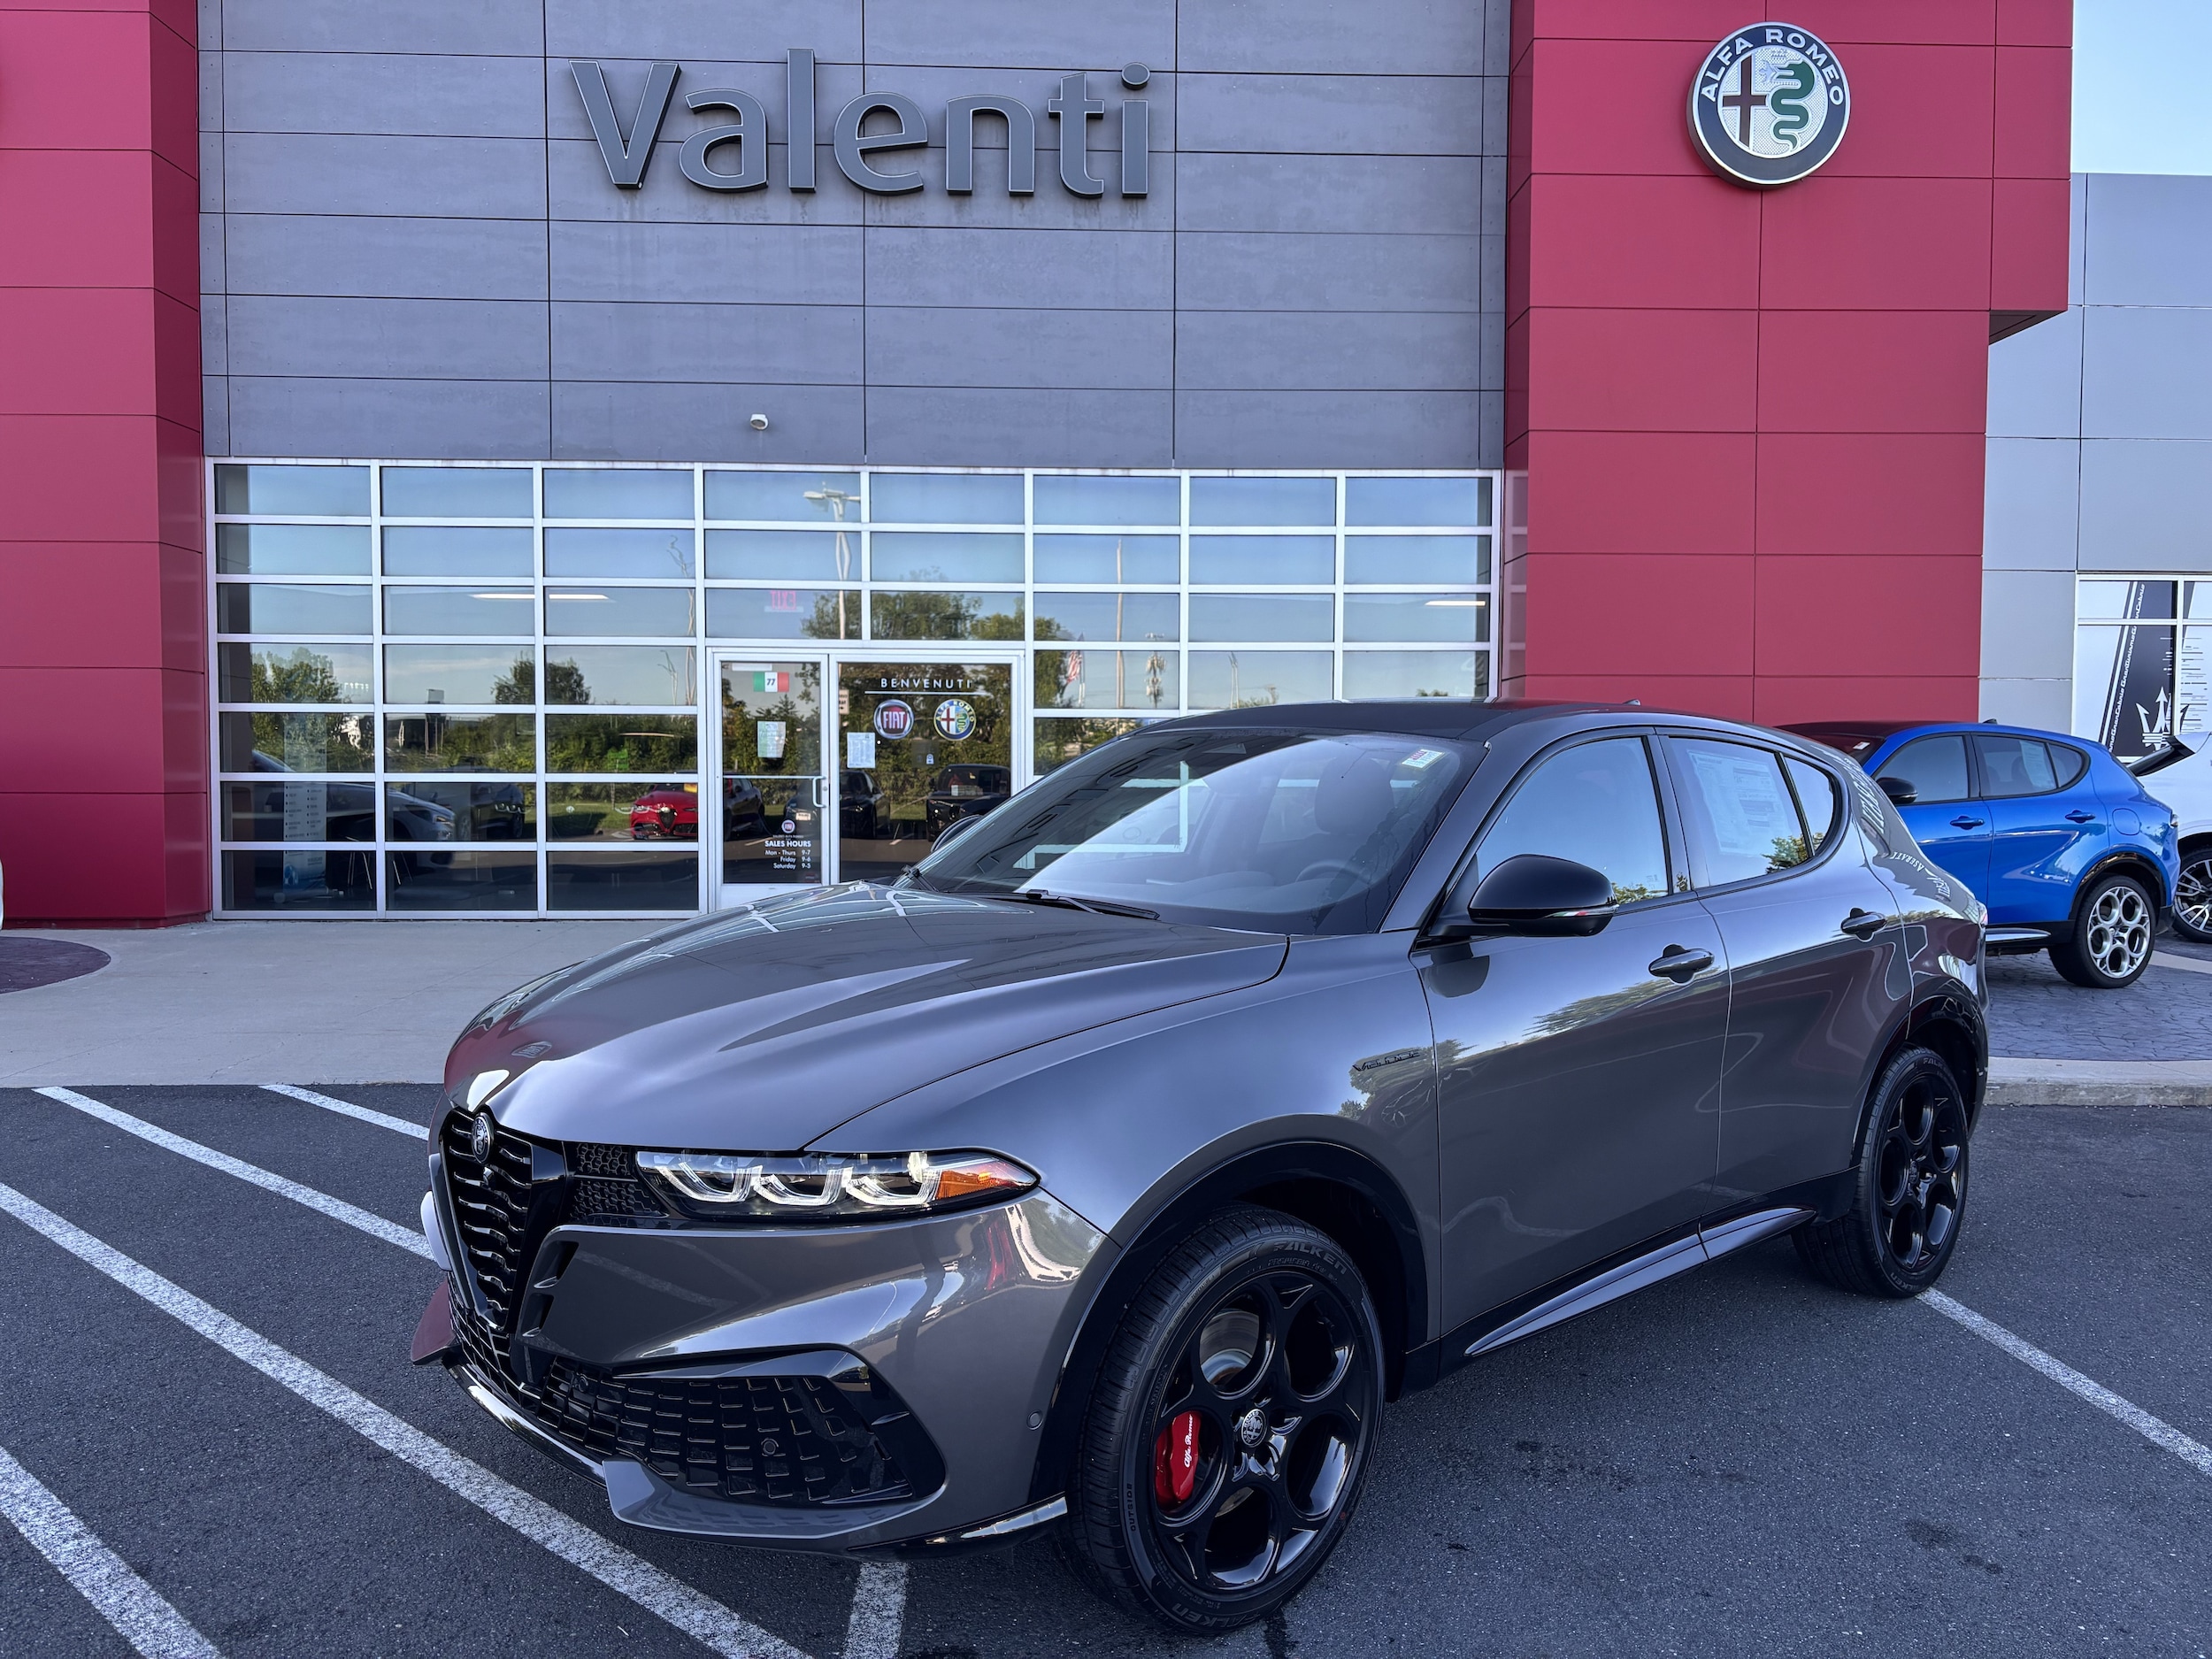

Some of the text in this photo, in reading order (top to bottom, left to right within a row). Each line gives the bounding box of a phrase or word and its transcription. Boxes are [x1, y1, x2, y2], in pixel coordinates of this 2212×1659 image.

[1701, 28, 1844, 105] ALFA ROMEO
[567, 49, 1151, 198] Valenti
[880, 678, 972, 688] BENVENUTI
[882, 710, 906, 729] FIAT
[936, 700, 974, 722] ALFA ROMEO
[1273, 1240, 1348, 1275] FALKEN
[1126, 1483, 1136, 1532] OUTSIDE
